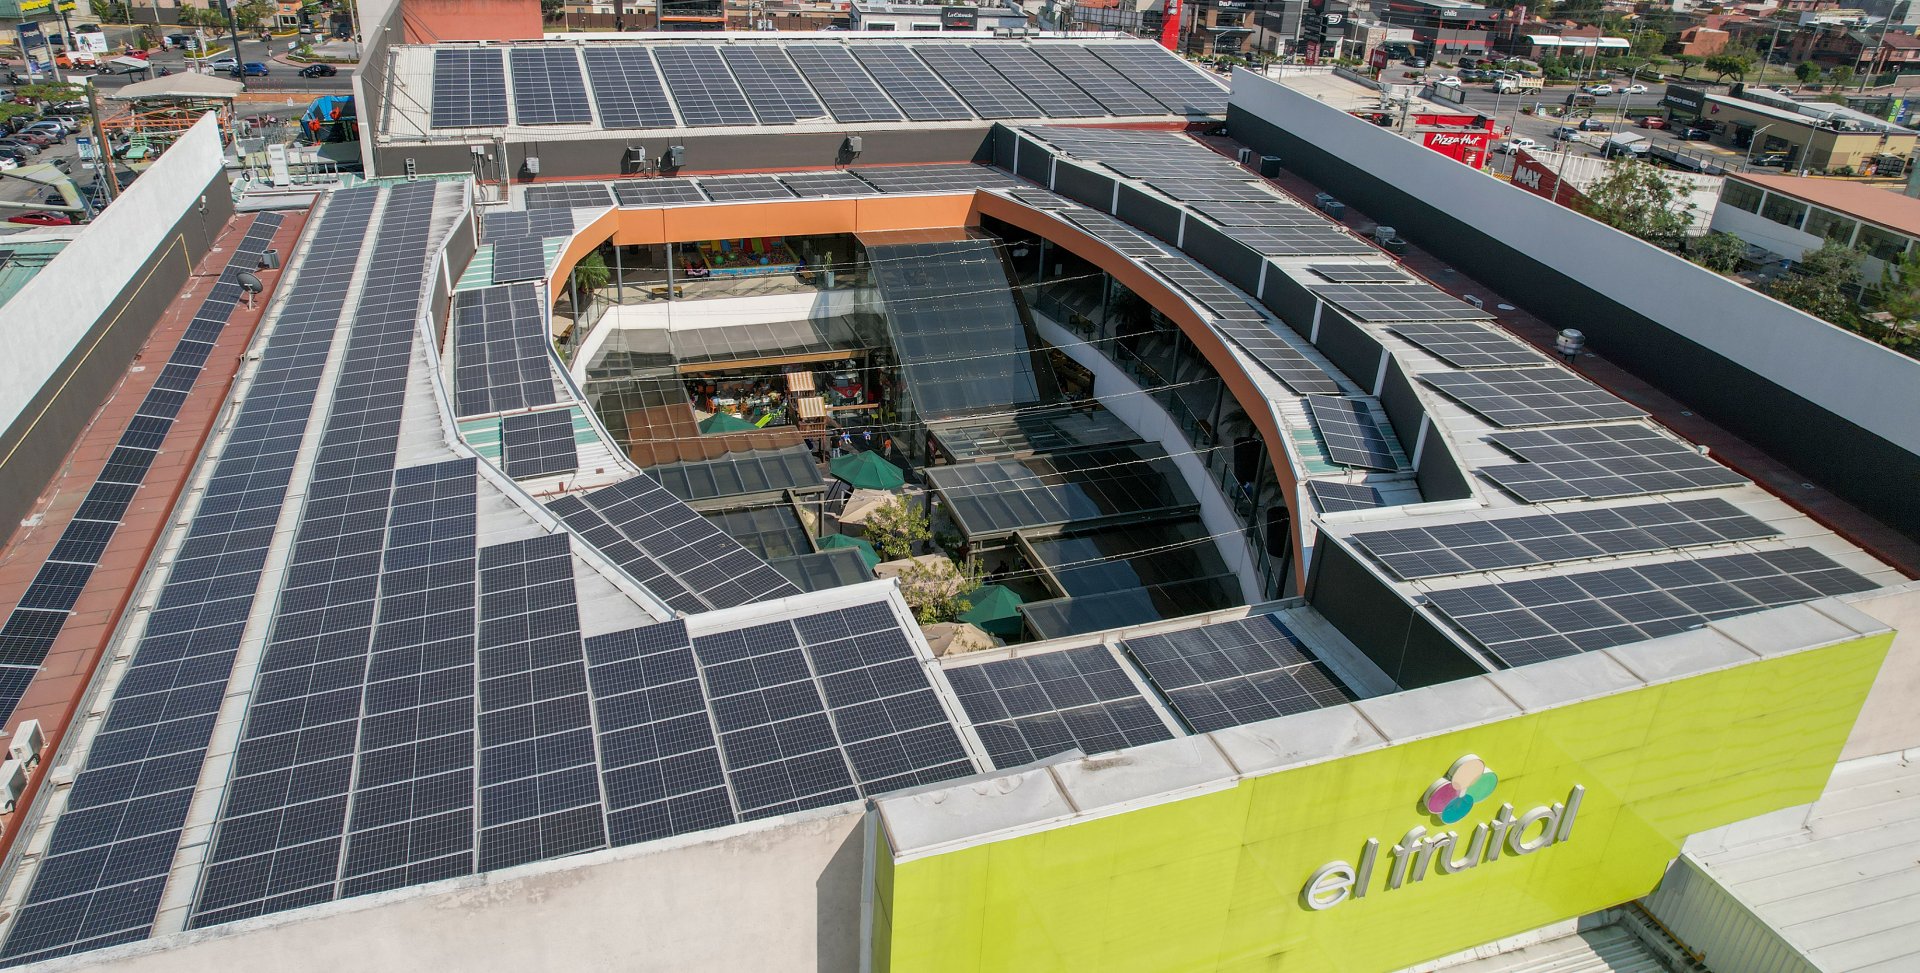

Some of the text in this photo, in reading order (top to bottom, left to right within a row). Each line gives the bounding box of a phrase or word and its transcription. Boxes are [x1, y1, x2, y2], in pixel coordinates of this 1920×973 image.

[1430, 133, 1482, 146] Pizza Hut
[1514, 164, 1543, 191] MAX
[1303, 784, 1586, 911] el frutal
